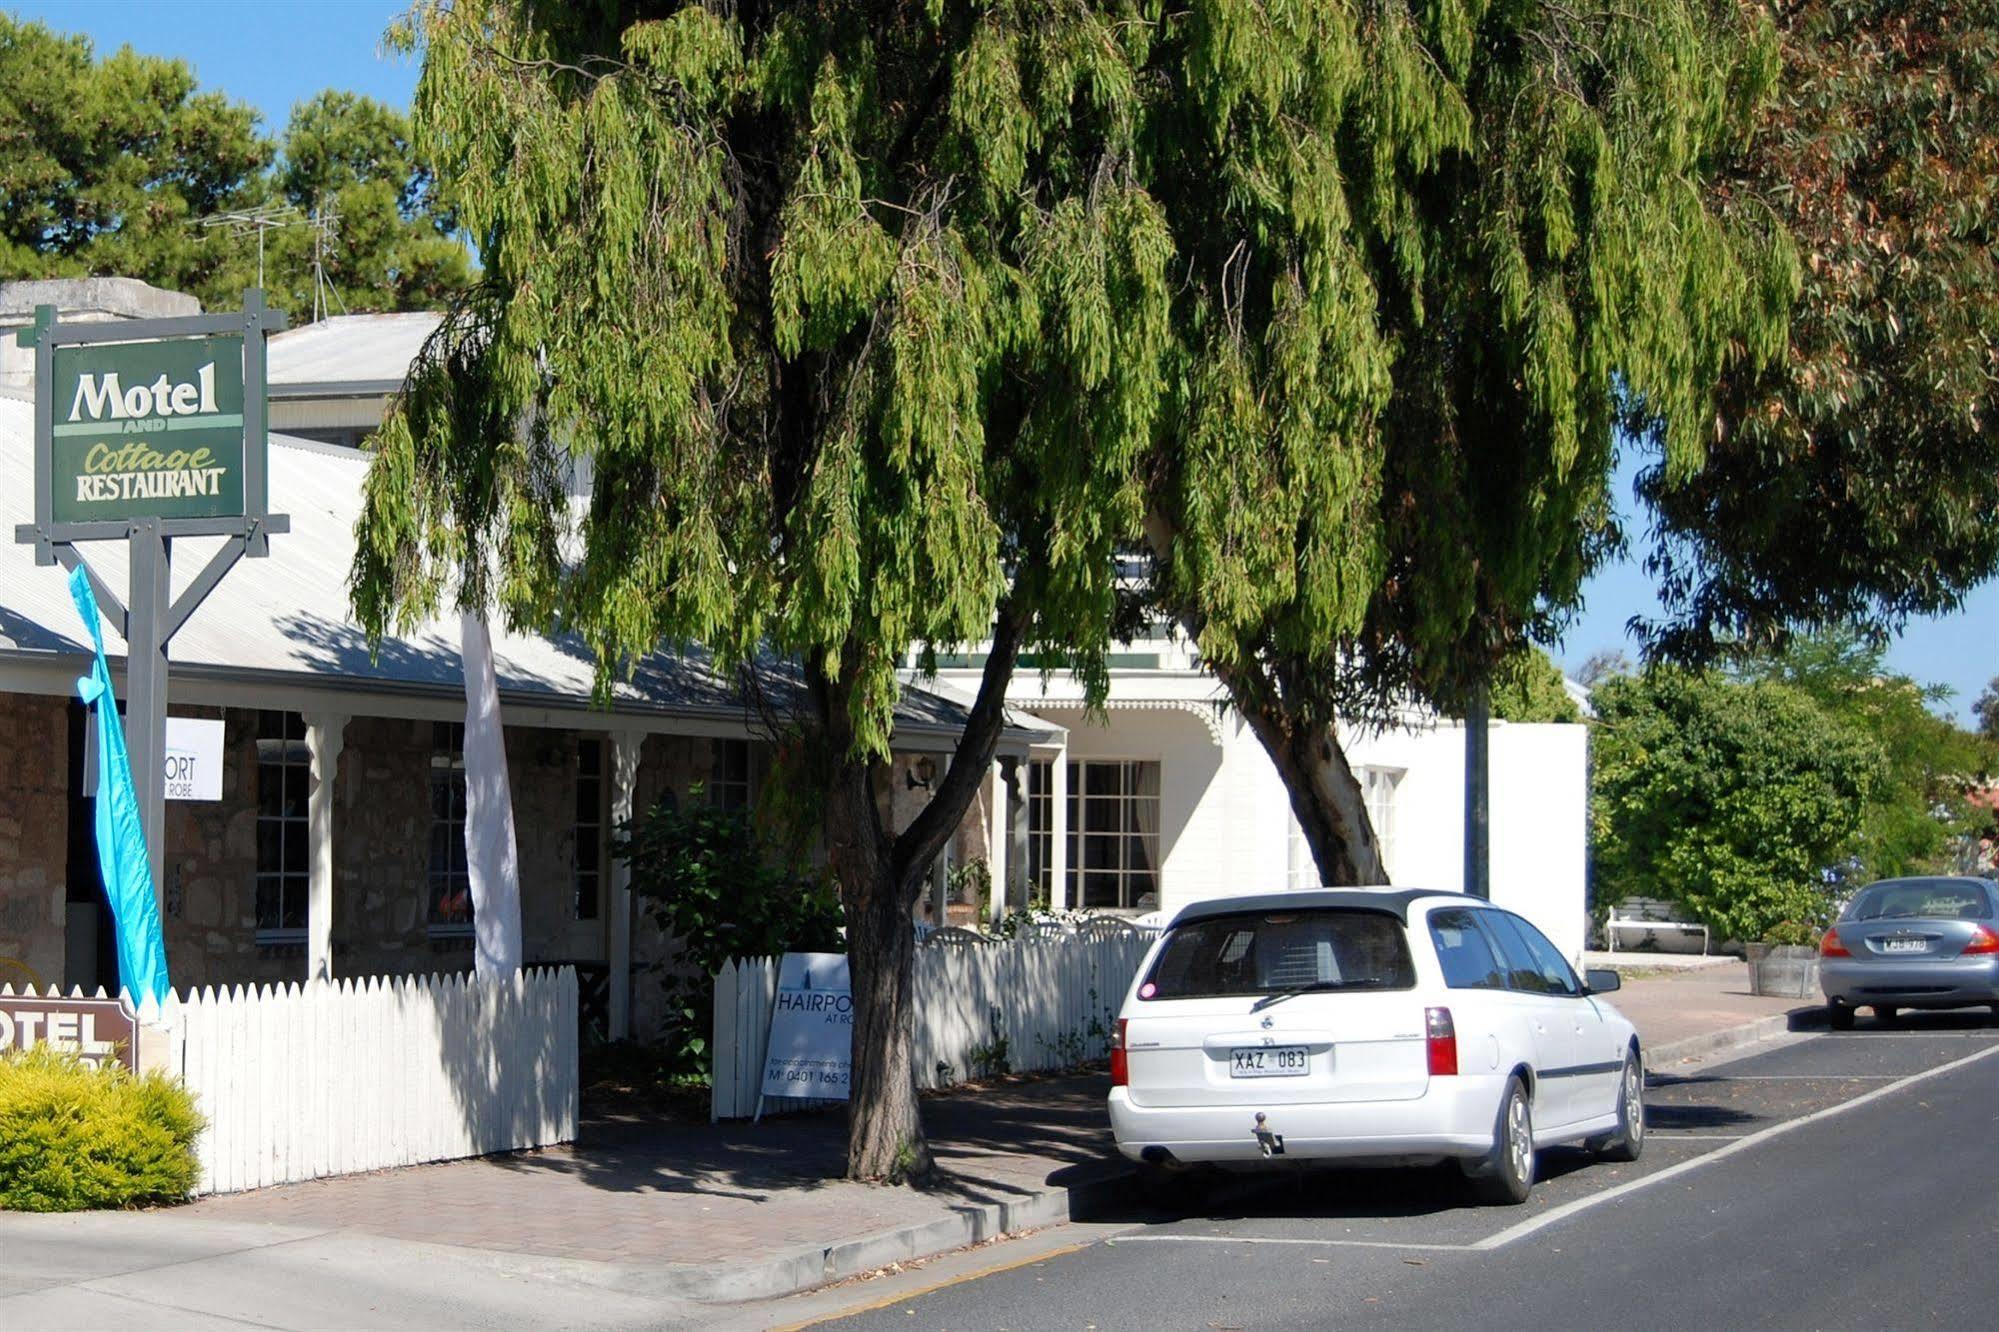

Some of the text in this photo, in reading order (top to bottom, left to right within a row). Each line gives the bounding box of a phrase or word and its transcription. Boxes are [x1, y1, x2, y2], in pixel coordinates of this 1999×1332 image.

[68, 361, 219, 421] Motel
[123, 418, 167, 434] AND
[84, 442, 216, 474] Cottage
[76, 467, 226, 502] RESTAURANT
[164, 756, 195, 780] ORT
[168, 783, 193, 797] ROBE
[824, 1013, 838, 1024] AT
[1235, 1051, 1305, 1069] XAZ 083
[787, 1071, 814, 1082] 0401
